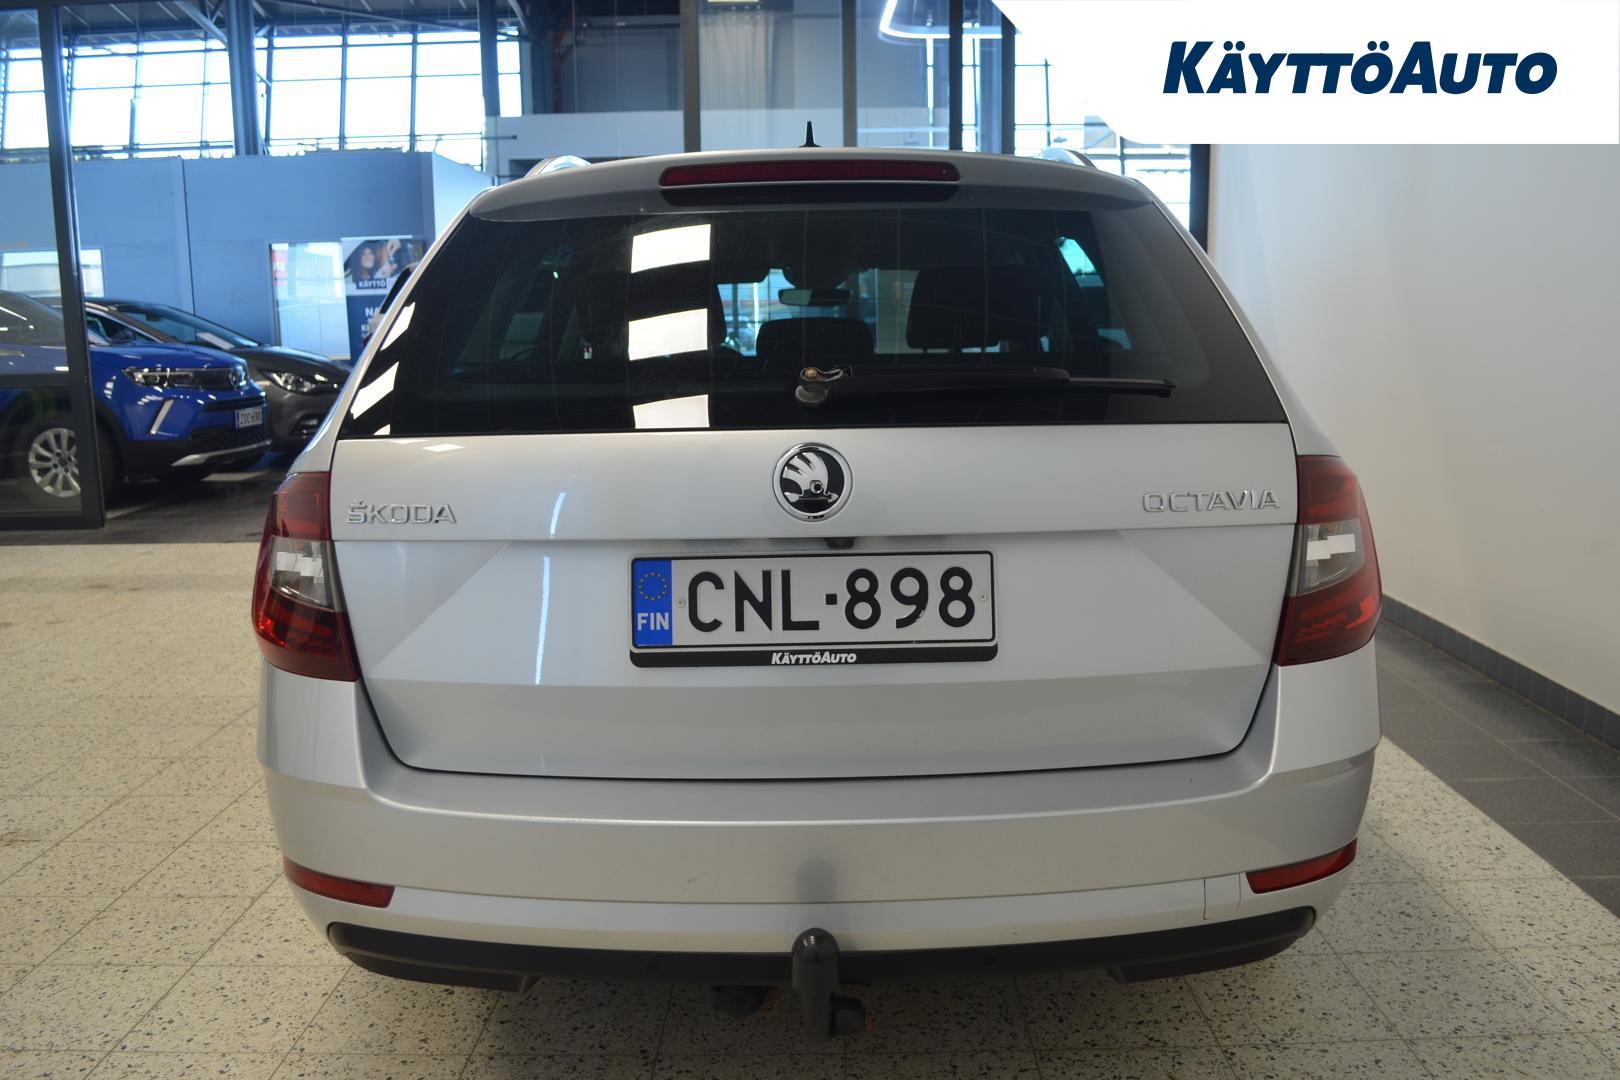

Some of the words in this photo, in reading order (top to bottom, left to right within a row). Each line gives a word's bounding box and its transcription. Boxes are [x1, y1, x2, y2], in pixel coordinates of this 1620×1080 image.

[345, 499, 458, 524] ŠKODA
[1142, 489, 1281, 513] OCTAVIA
[688, 566, 975, 632] CNL-898
[636, 611, 669, 631] FIN
[771, 651, 857, 665] KÄYTTÖAUTO
